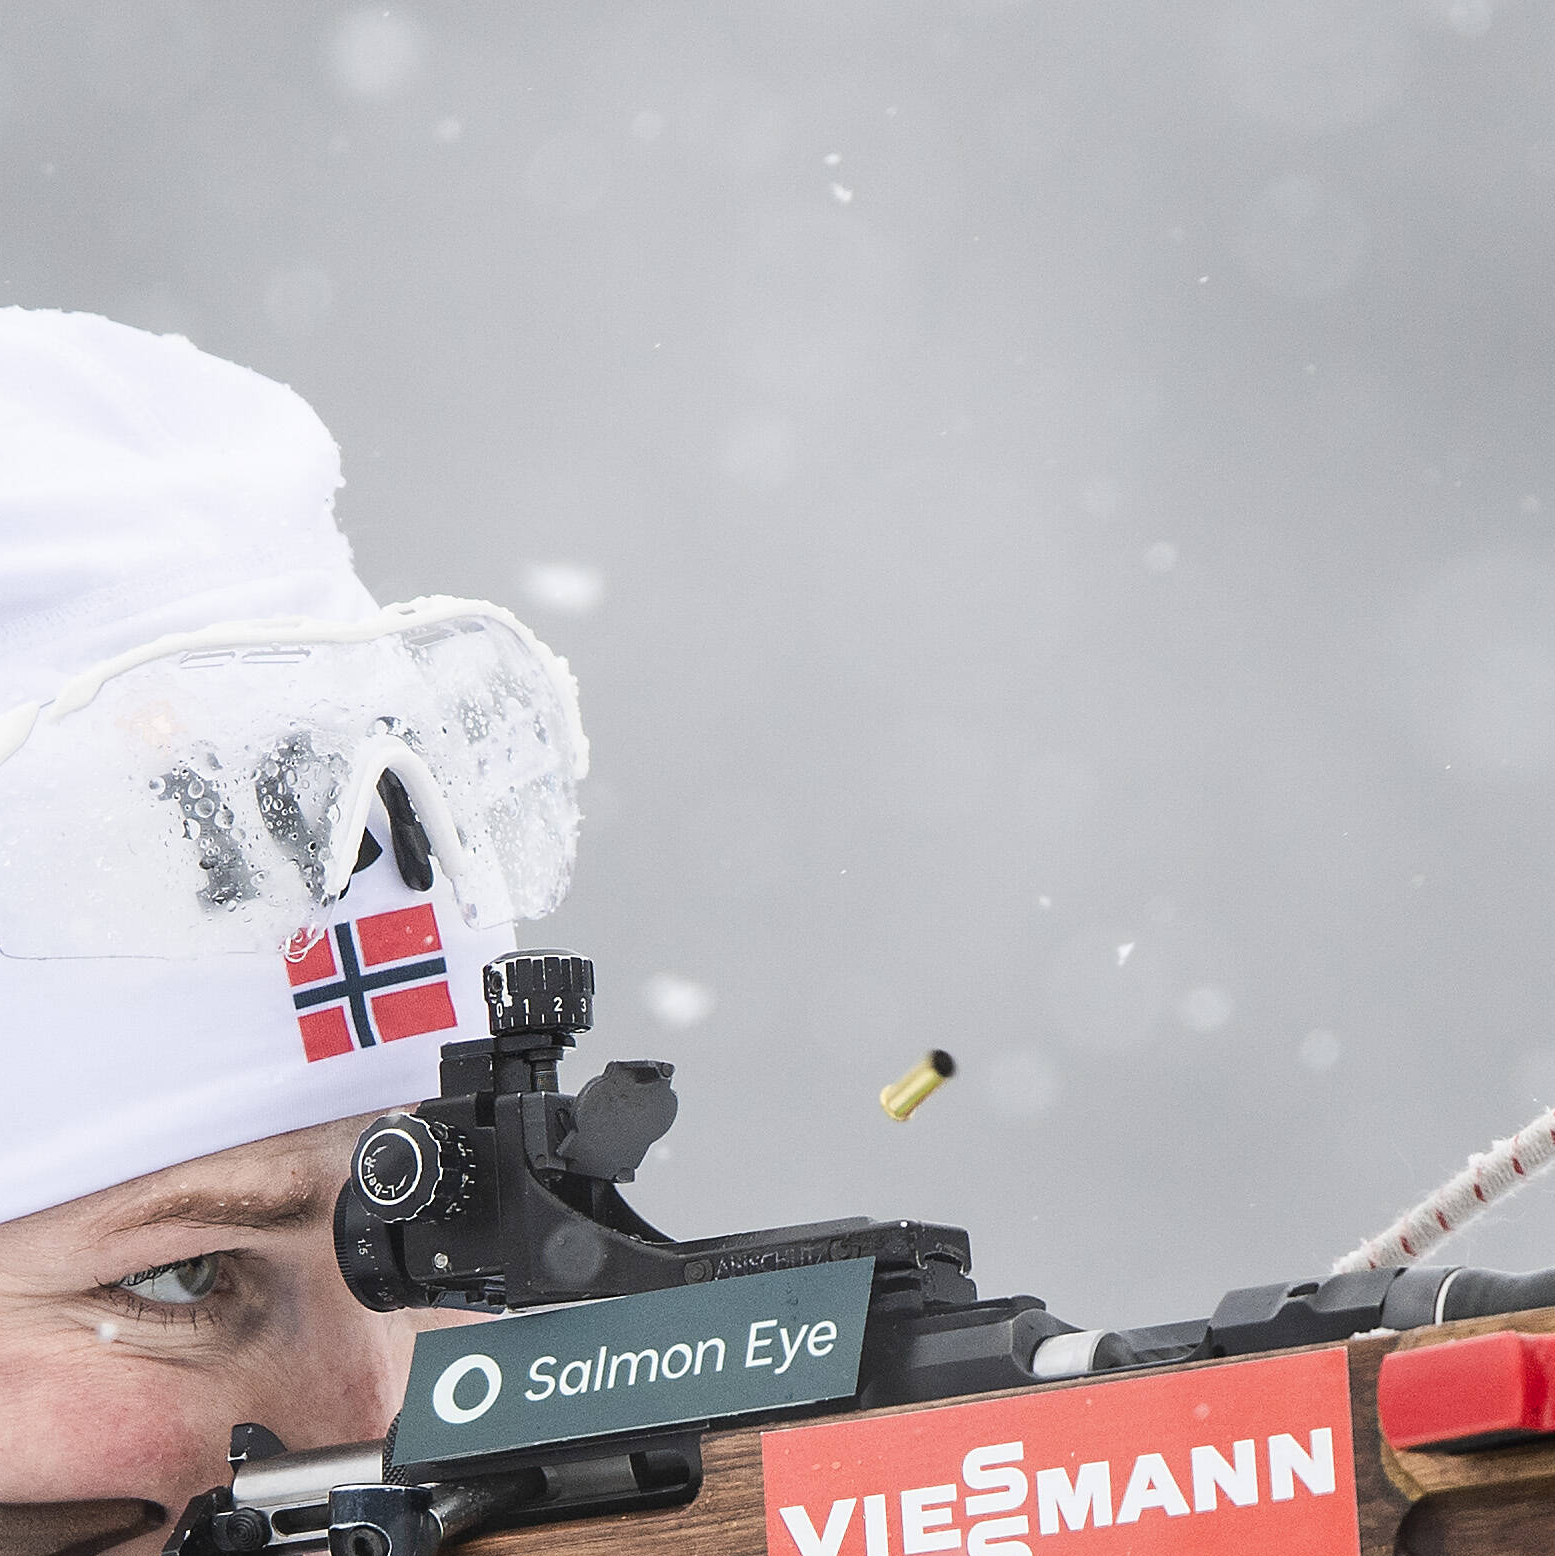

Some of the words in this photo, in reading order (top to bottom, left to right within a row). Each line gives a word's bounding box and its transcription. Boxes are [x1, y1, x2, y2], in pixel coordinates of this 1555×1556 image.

[523, 998, 530, 1014] 1
[553, 996, 563, 1012] 2
[580, 997, 587, 1013] 3
[524, 1338, 726, 1402] Salmon
[745, 1319, 838, 1375] Eye
